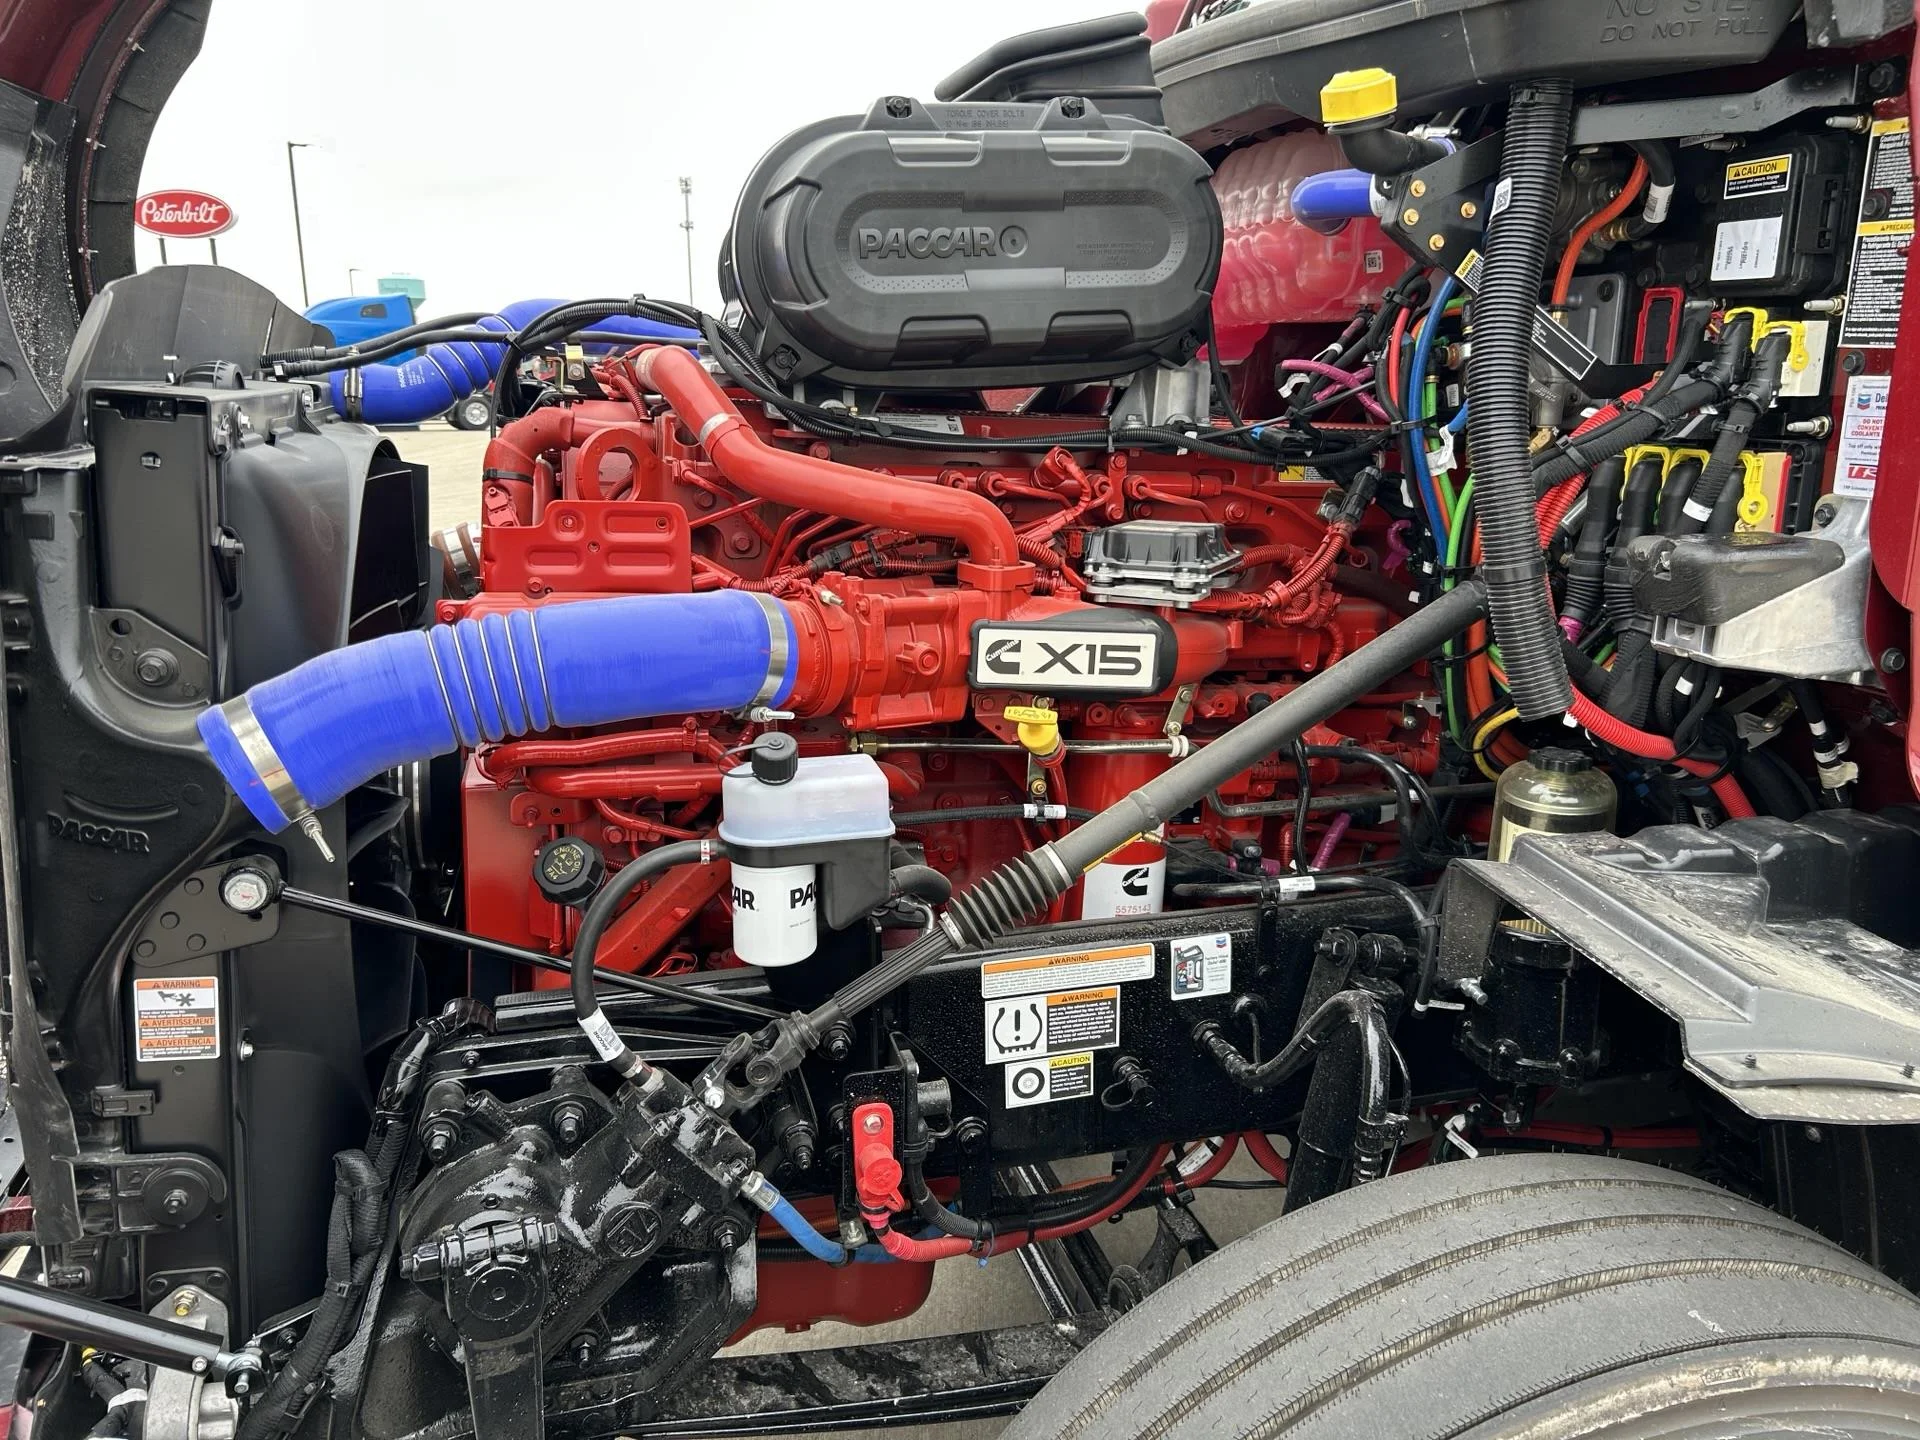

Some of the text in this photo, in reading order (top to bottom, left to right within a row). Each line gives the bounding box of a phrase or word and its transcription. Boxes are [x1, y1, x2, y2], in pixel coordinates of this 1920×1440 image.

[1600, 17, 1769, 43] DO NOT PULL
[1741, 162, 1778, 177] CAUTION
[141, 199, 224, 225] Peterbilt
[859, 227, 996, 259] PACCAR
[1033, 642, 1142, 675] X15
[47, 810, 150, 853] PACCAR
[1115, 904, 1151, 914] 5575143
[1053, 954, 1090, 965] WARNING
[162, 980, 201, 989] WARNING
[1067, 991, 1103, 1002] WARNING
[152, 1018, 213, 1027] AVERTISSEMENT
[157, 1038, 211, 1047] ADVERTENCIA
[1057, 1056, 1090, 1066] CAUTION
